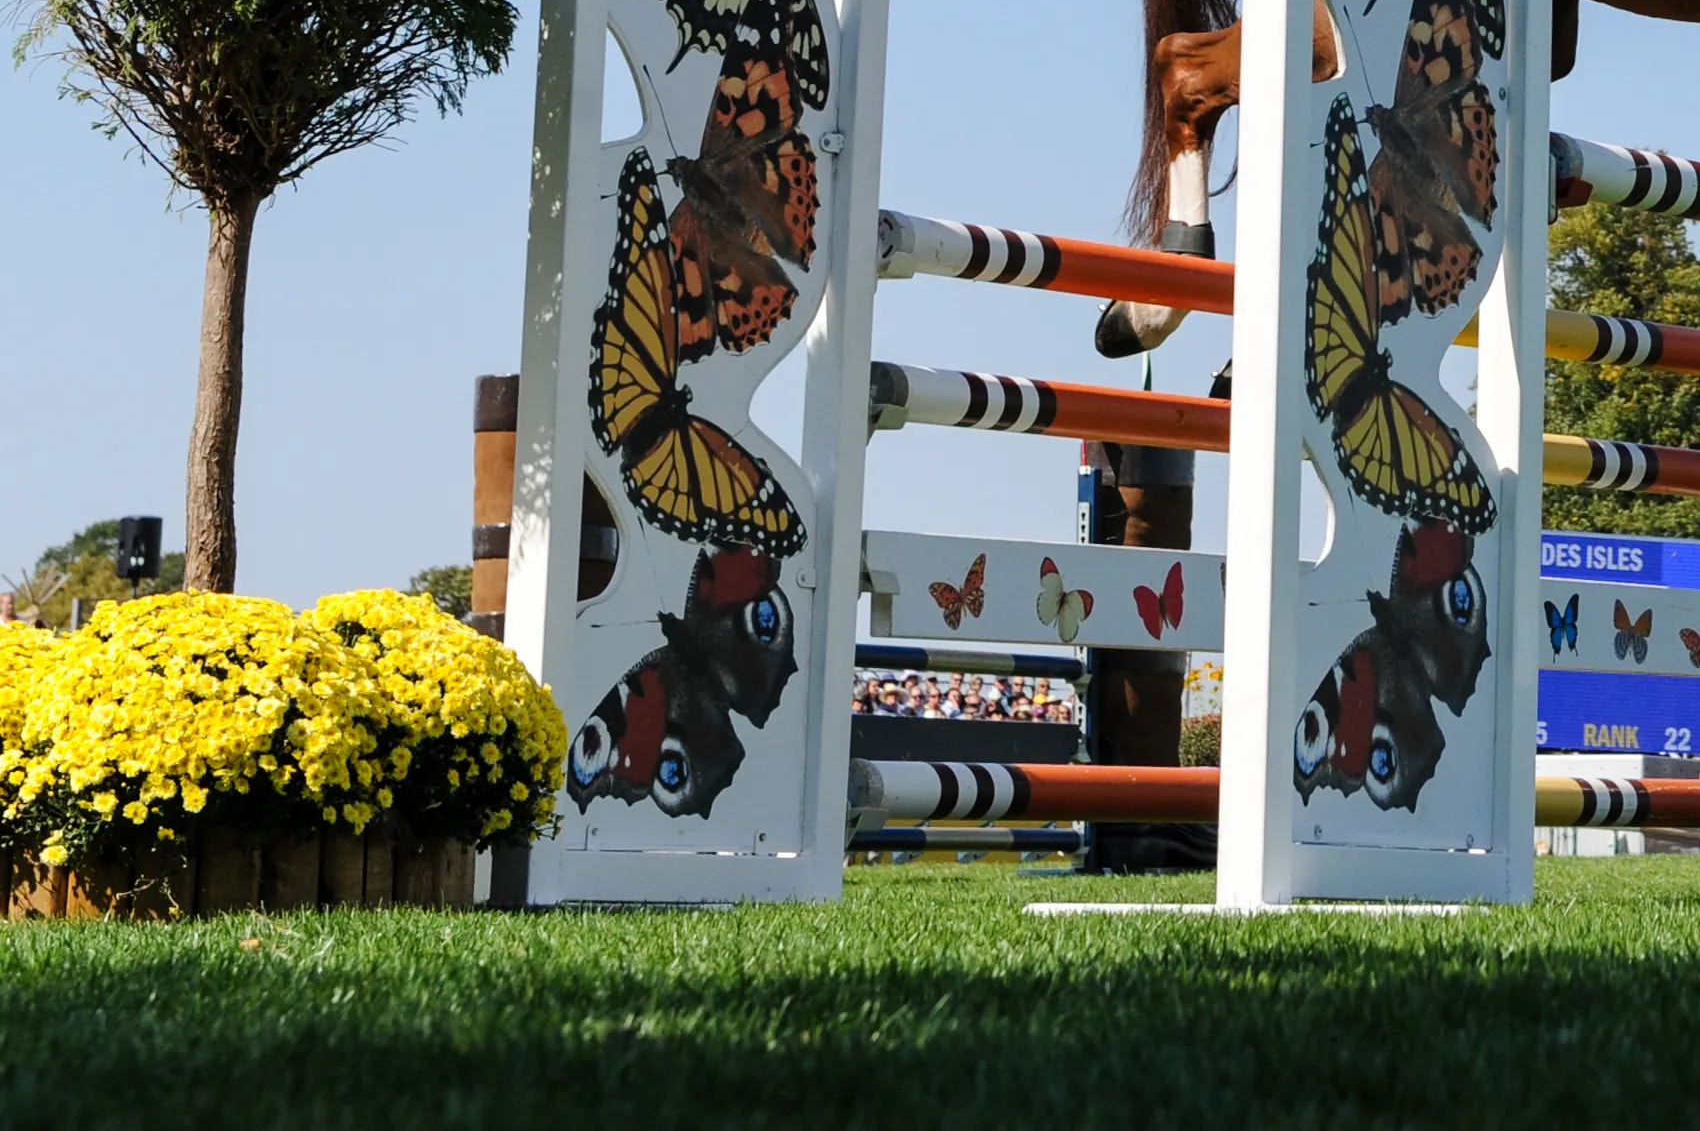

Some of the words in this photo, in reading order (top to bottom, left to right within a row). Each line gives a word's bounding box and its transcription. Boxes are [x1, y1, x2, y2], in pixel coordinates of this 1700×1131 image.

[1541, 542, 1581, 568] DES
[1586, 545, 1644, 572] ISLES
[1584, 723, 1640, 749] RANK
[1664, 727, 1691, 751] 22
